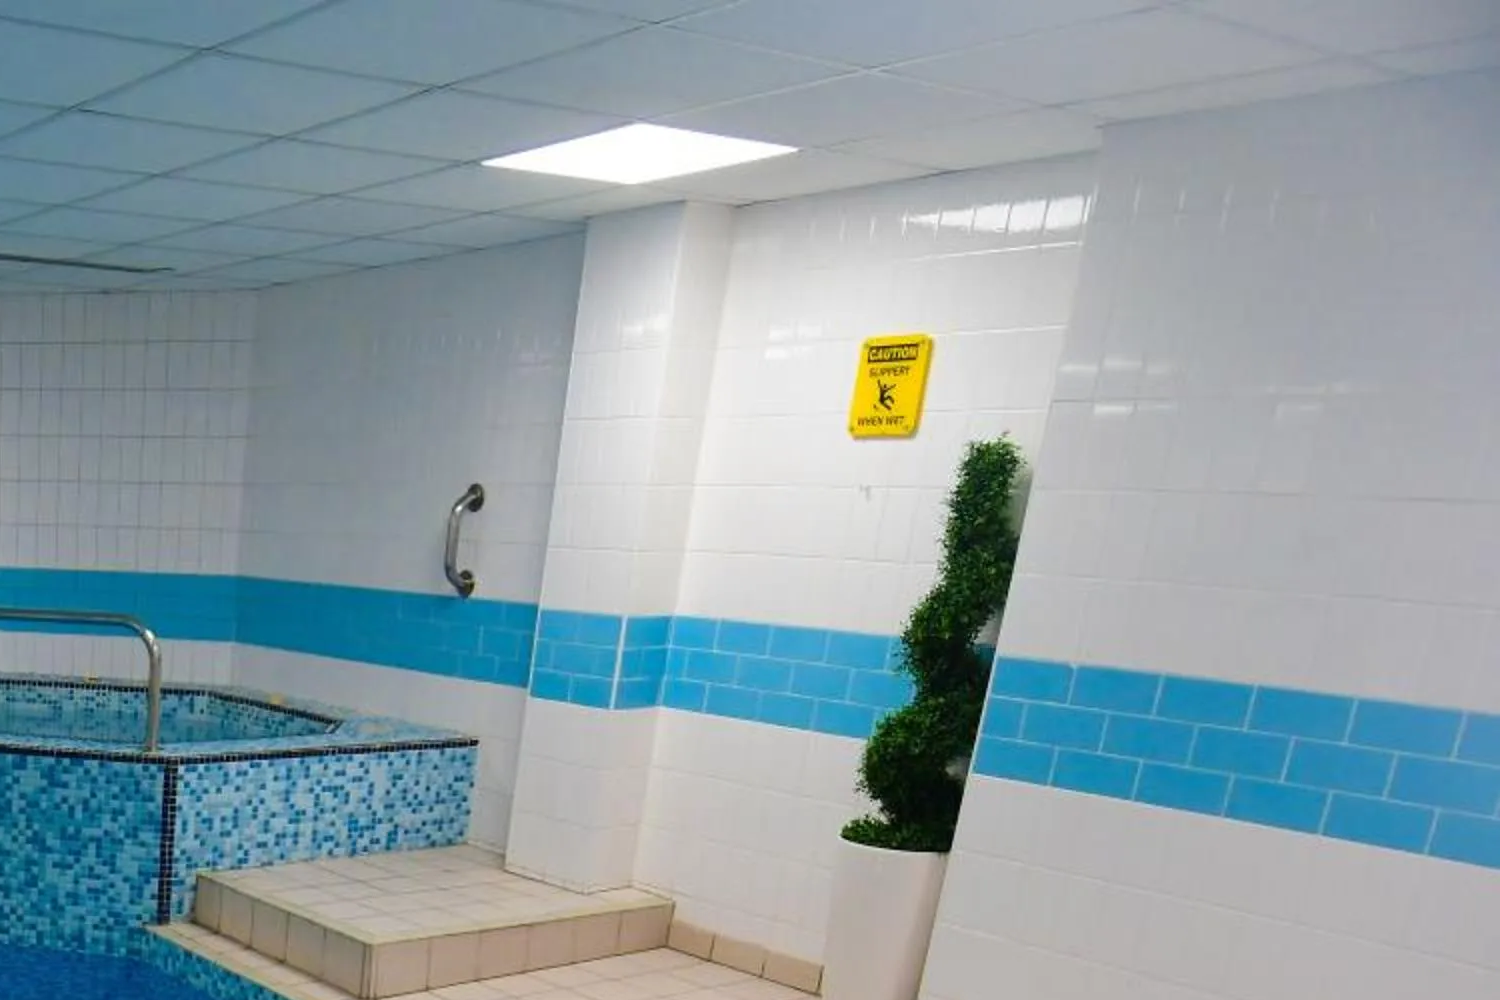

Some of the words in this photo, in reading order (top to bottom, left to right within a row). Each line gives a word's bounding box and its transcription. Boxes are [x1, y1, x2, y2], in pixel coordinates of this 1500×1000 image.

[869, 346, 917, 361] CAUTION
[869, 366, 911, 377] SLIPPERY
[857, 416, 885, 426] WHEN
